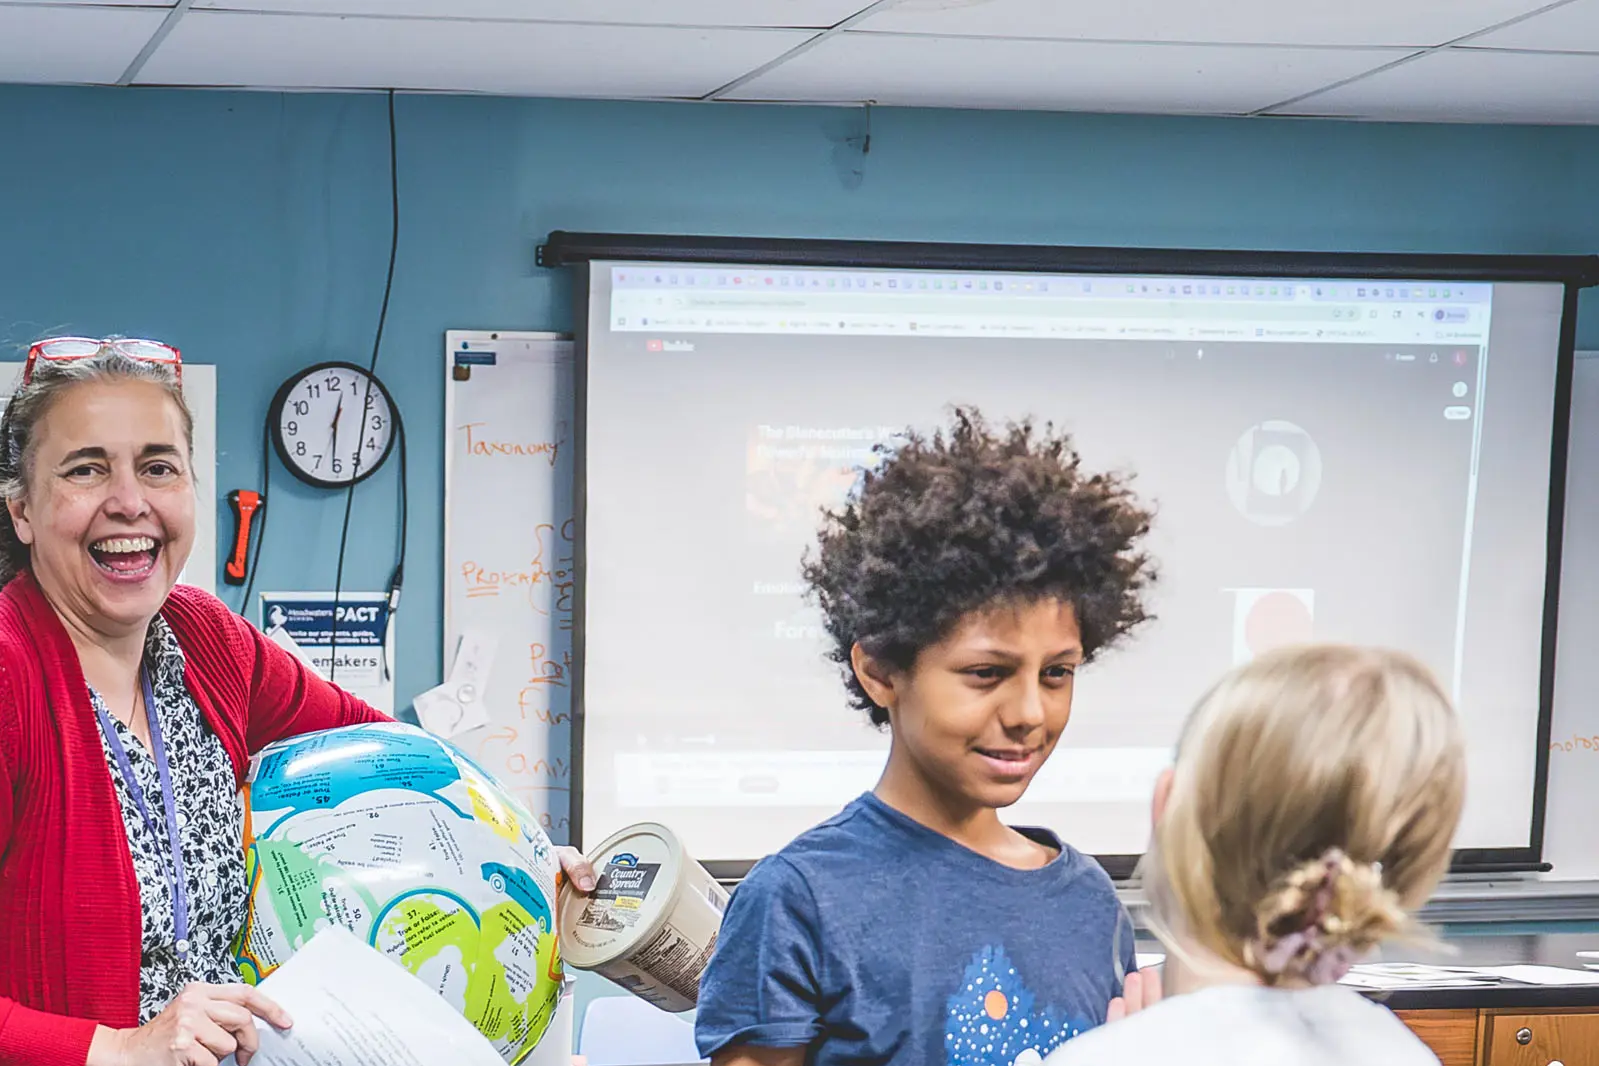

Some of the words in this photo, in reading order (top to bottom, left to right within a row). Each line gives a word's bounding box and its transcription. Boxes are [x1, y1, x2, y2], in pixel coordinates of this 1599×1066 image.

[306, 384, 320, 398] 11
[324, 376, 341, 392] 12
[350, 381, 357, 396] 1
[293, 400, 309, 416] 10
[287, 420, 298, 436] 9
[371, 415, 382, 430] 3
[296, 441, 306, 456] 8
[366, 437, 375, 450] 4
[458, 421, 567, 466] Taxonomy
[312, 455, 322, 469] 7
[332, 458, 342, 473] 6
[312, 795, 331, 805] 45.
[366, 811, 380, 821] 92.
[610, 868, 648, 883] Country
[609, 877, 643, 890] Spread
[328, 887, 344, 924] Deforestatio
[352, 908, 362, 922] 50.
[407, 909, 420, 920] 37.
[397, 926, 412, 937] True
[413, 920, 420, 928] or
[420, 910, 440, 923] False:
[265, 927, 274, 940] 18.
[386, 940, 405, 954] Hybrid
[406, 933, 417, 943] cars
[417, 924, 431, 935] refer
[442, 964, 451, 982] Which
